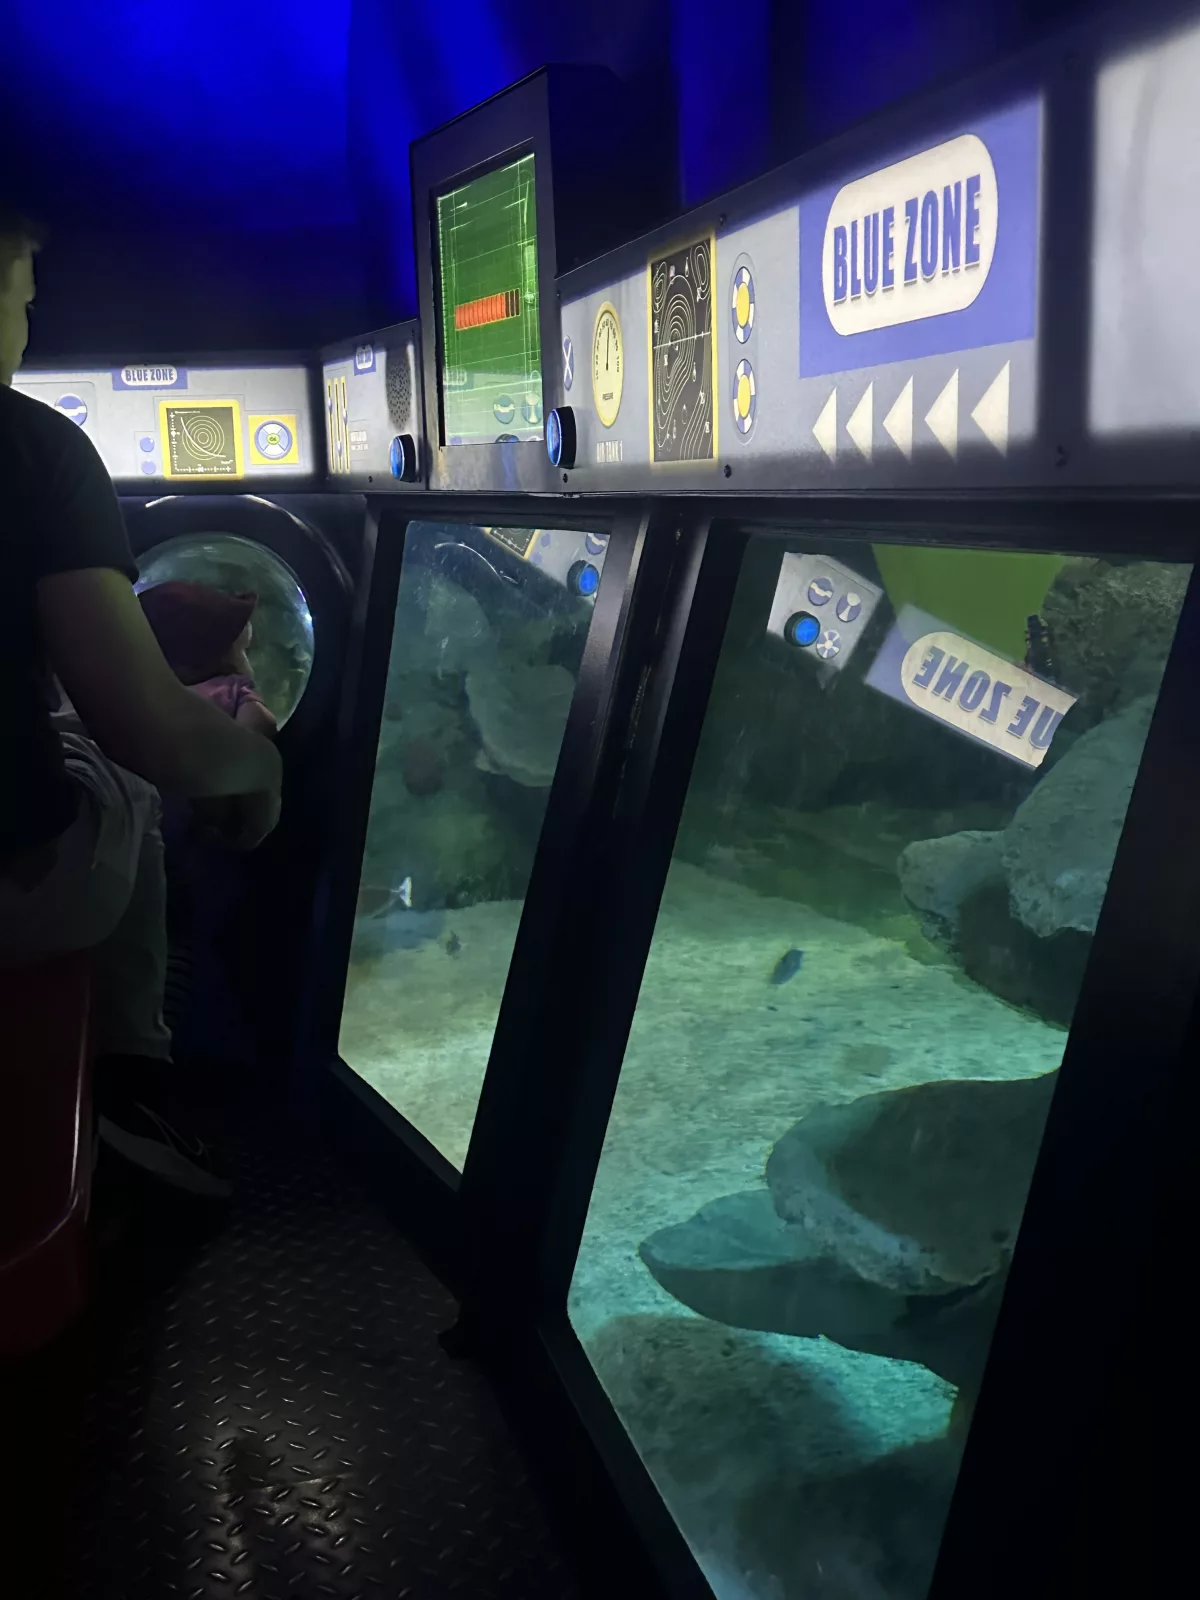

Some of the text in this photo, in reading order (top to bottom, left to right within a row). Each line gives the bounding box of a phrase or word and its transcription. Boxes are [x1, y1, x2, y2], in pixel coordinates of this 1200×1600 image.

[834, 174, 981, 304] BLUE ZONE
[125, 368, 174, 382] BLUE ZONE
